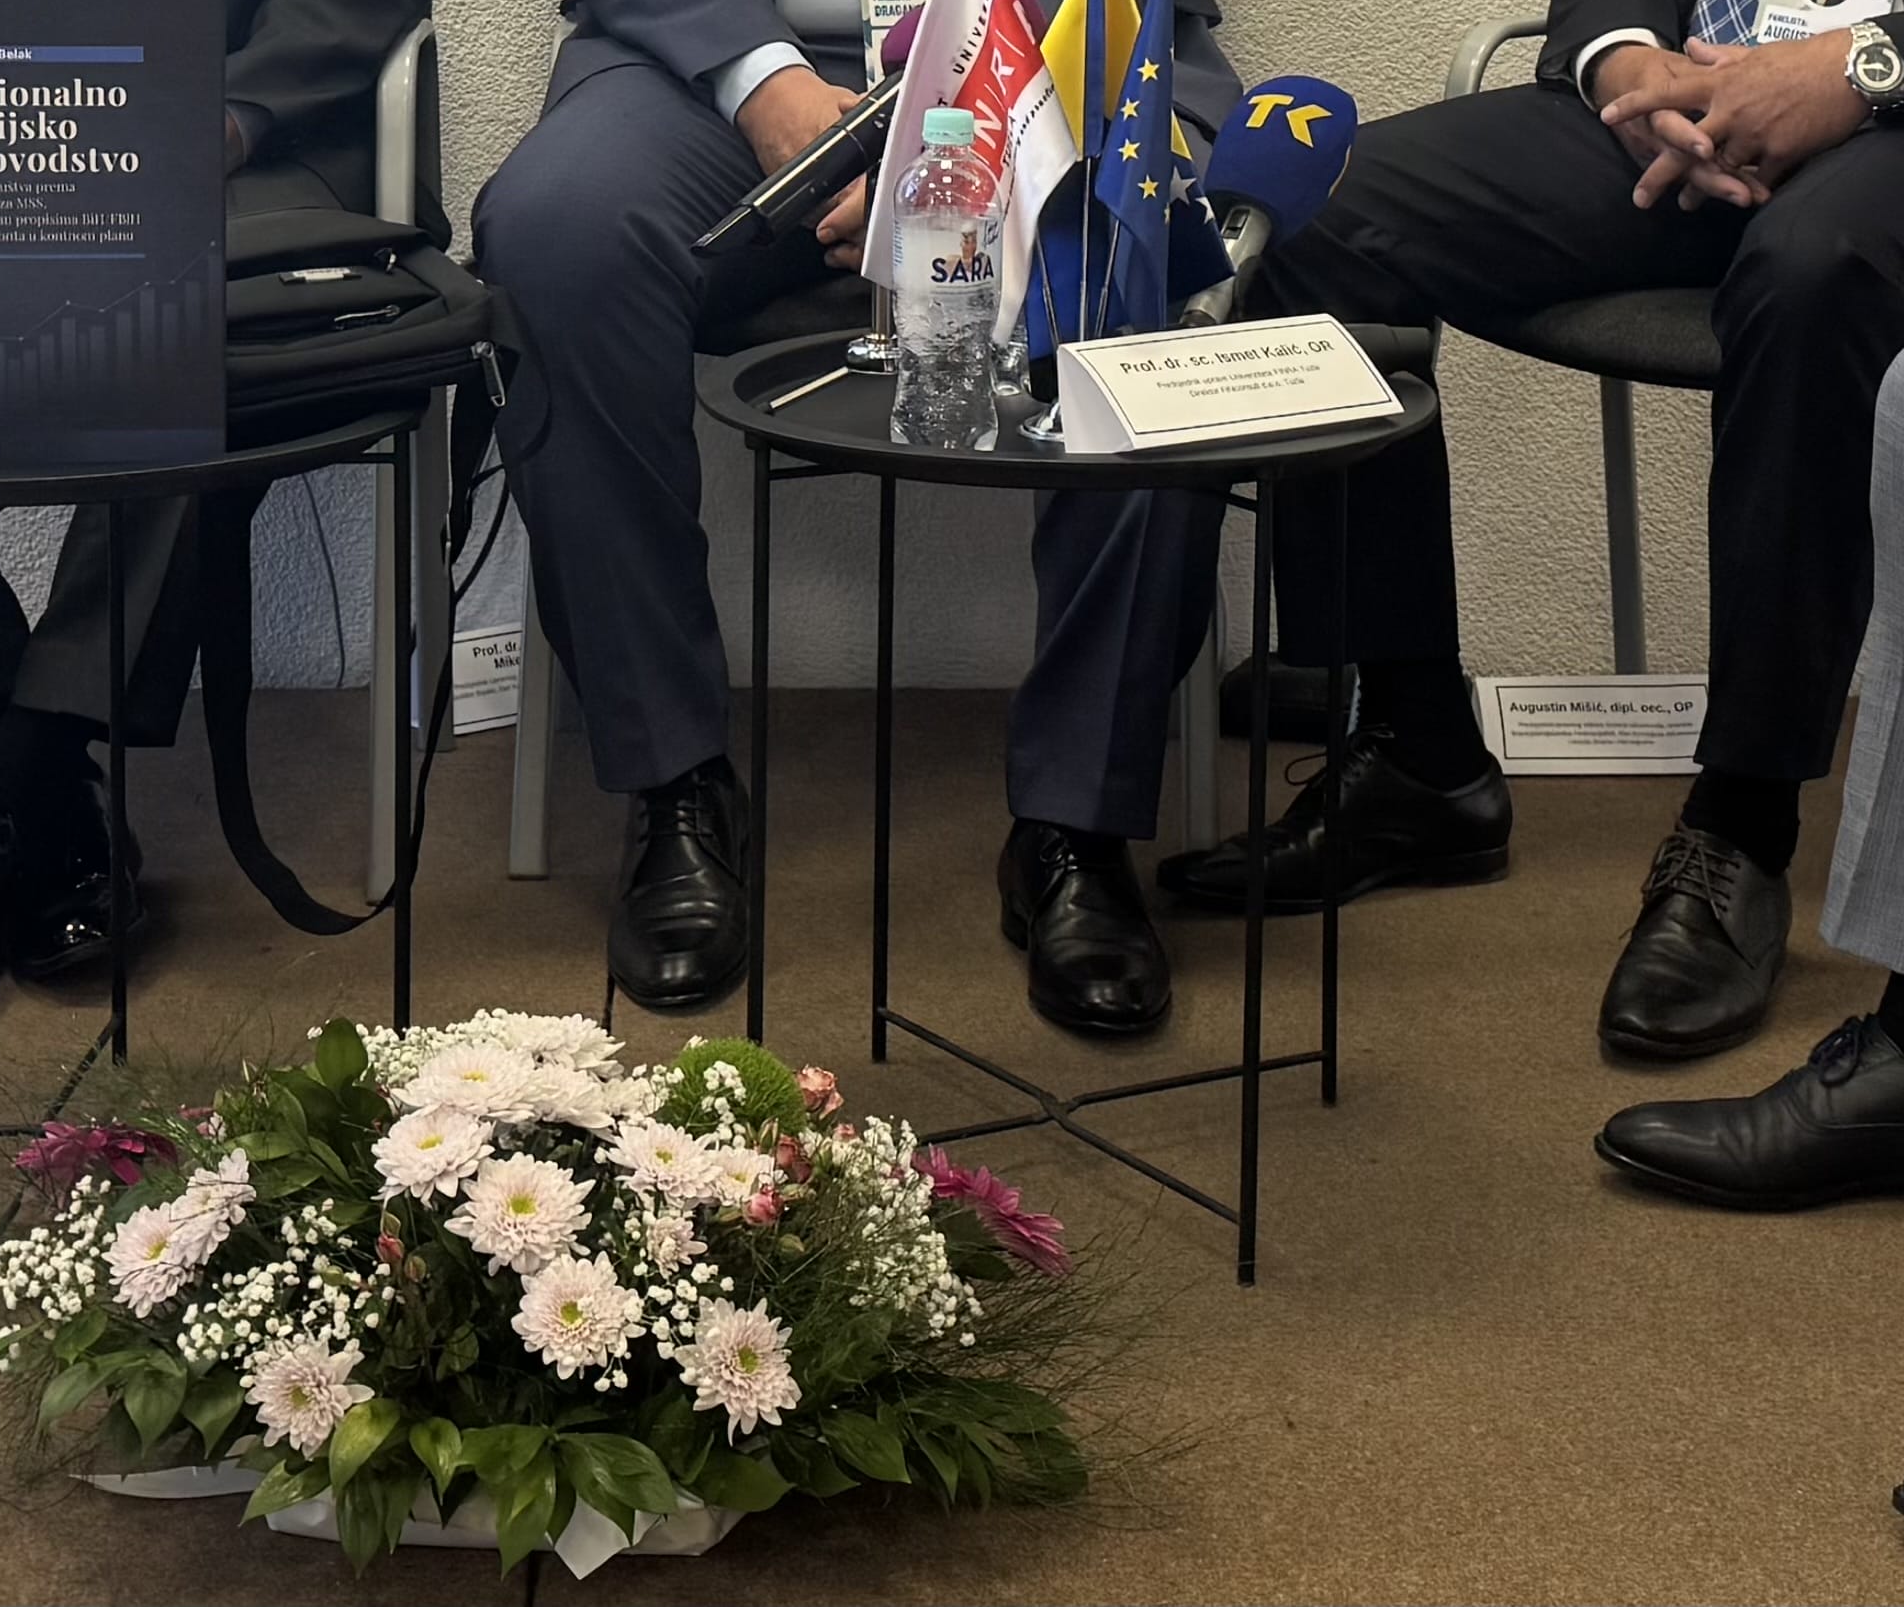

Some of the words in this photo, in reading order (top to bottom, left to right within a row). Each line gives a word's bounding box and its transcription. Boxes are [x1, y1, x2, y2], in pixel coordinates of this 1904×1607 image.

[1763, 24, 1816, 40] AUGUS
[35, 183, 76, 195] prema
[15, 212, 78, 228] propisima
[40, 229, 96, 242] kontnom
[99, 228, 135, 244] planu
[931, 255, 995, 284] SARA
[1120, 357, 1163, 375] Prof.
[1164, 355, 1188, 371] dr.
[1190, 352, 1214, 367] sc.
[1215, 346, 1261, 365] Ismet
[1262, 342, 1307, 361] Kalić,
[1509, 701, 1567, 715] Augustin
[1569, 700, 1608, 715] Mišić,
[1610, 701, 1638, 715] dipl.
